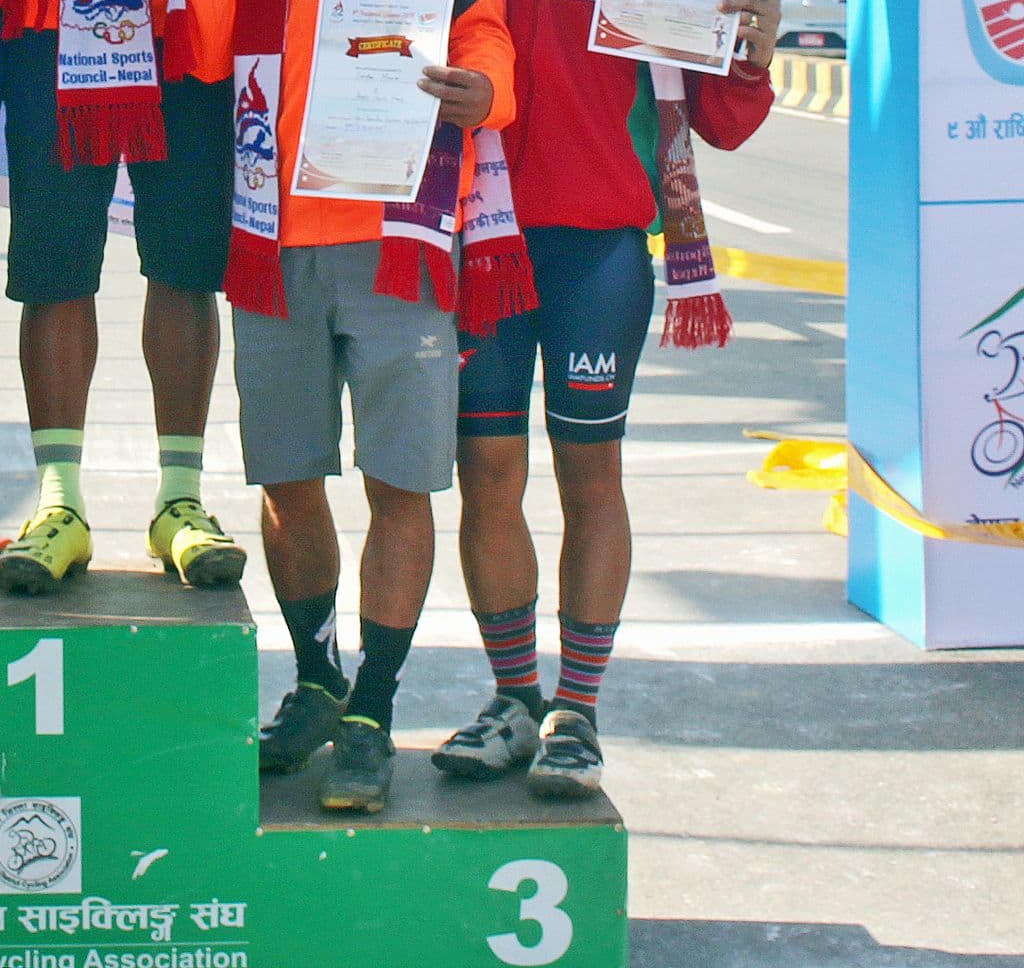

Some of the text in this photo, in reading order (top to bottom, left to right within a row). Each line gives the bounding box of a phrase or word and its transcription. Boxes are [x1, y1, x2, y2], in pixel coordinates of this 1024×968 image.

[59, 50, 154, 68] National Sports
[6, 639, 65, 735] 1
[189, 899, 247, 931] संघ
[487, 860, 573, 966] 3
[82, 946, 248, 968] Association
